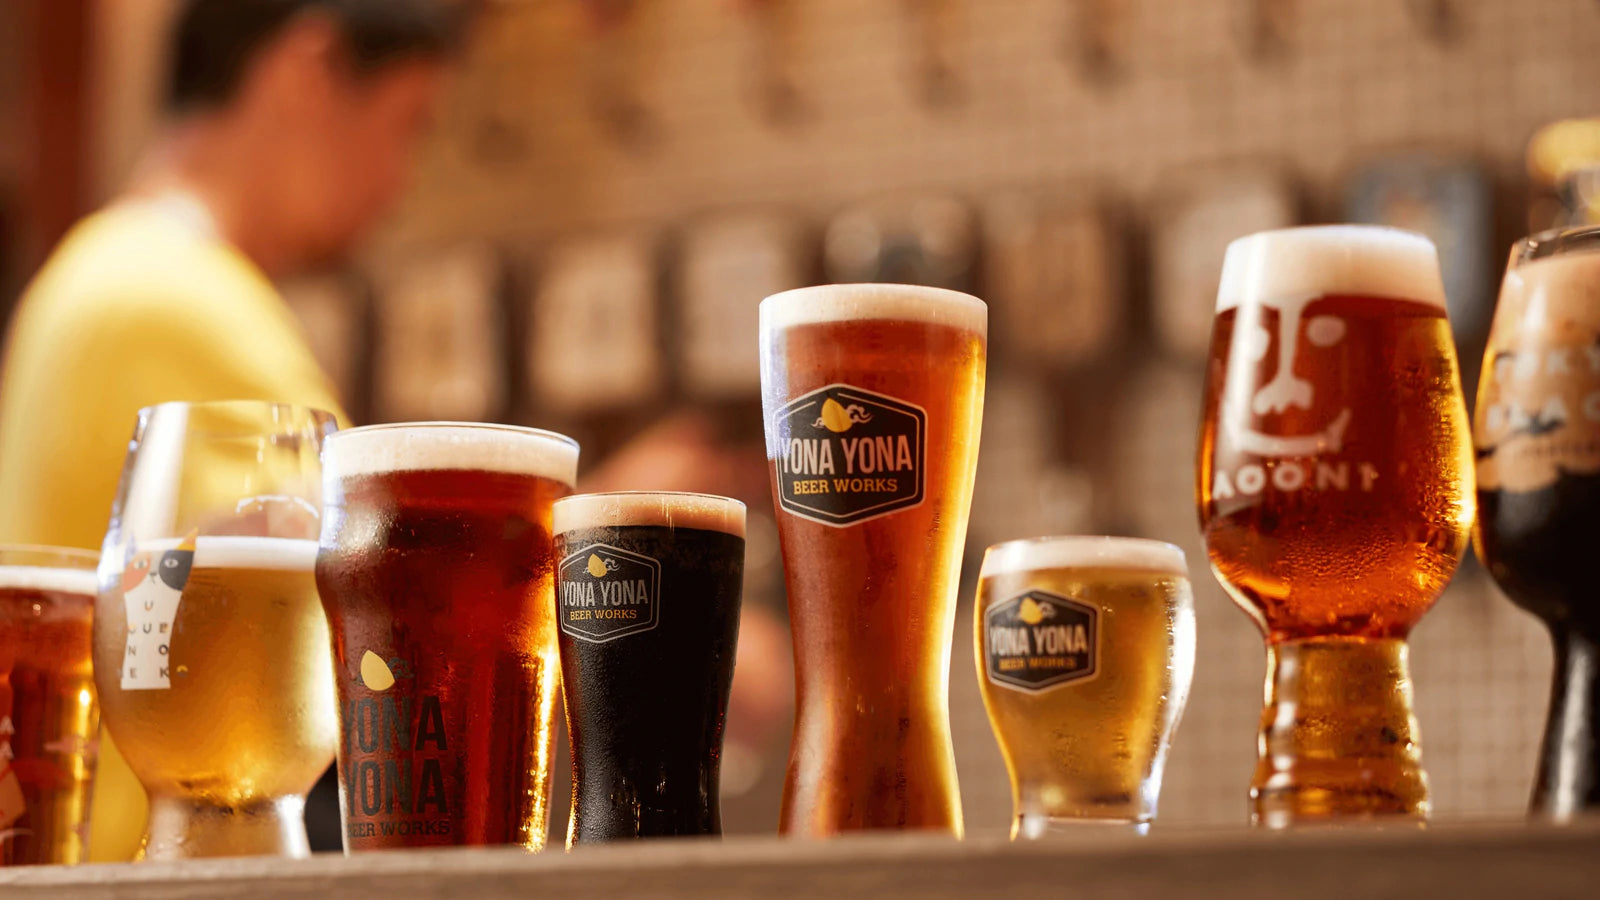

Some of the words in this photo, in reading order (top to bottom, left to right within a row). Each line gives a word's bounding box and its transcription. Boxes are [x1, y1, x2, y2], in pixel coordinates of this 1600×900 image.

[780, 437, 835, 476] YONA
[841, 434, 913, 475] YONA
[793, 479, 830, 495] BEER
[833, 478, 898, 493] WORKS
[563, 580, 596, 607] YONA
[599, 579, 649, 607] YONA
[570, 609, 592, 620] BEER
[594, 609, 637, 619] WORKS
[1032, 624, 1087, 655] YONA
[340, 696, 448, 754] YONA
[344, 759, 449, 817] YONA
[379, 820, 450, 837] WORKS
